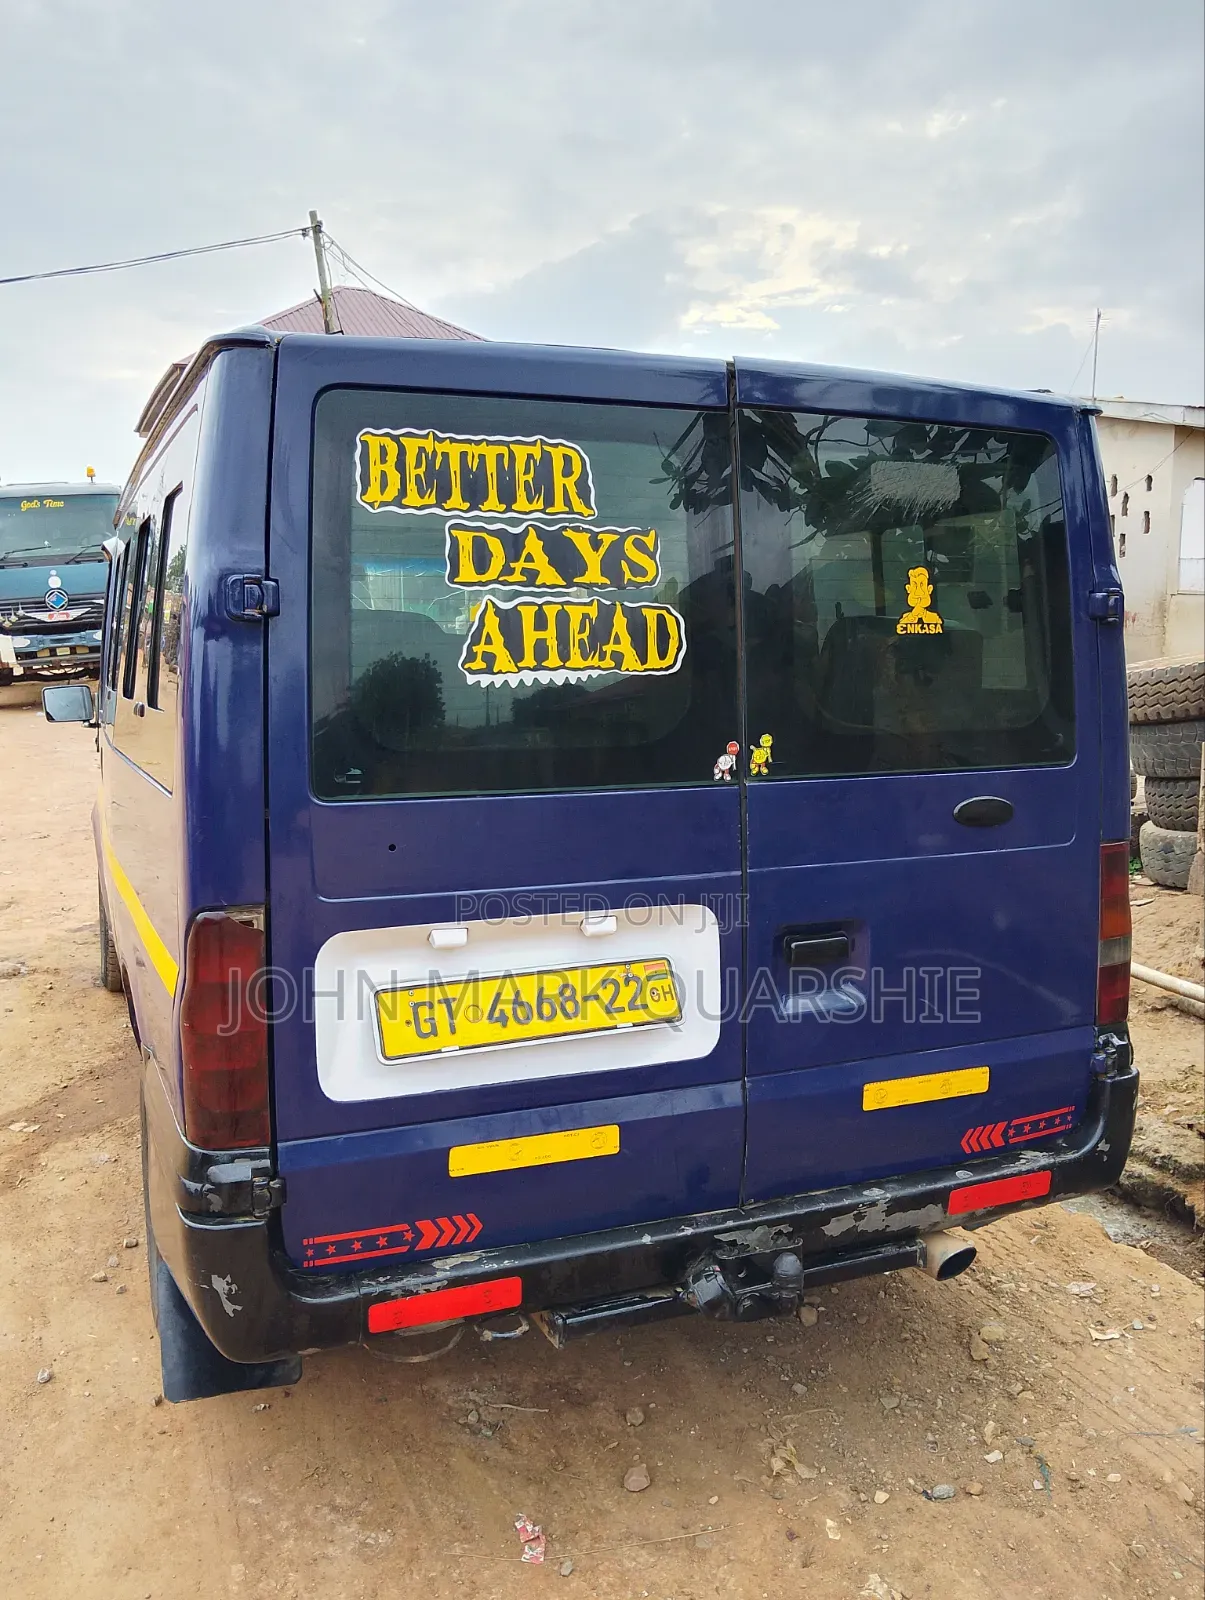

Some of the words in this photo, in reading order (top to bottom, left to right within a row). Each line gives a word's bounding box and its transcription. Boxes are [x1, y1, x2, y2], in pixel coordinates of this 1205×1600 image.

[360, 431, 594, 516] BETTER
[450, 526, 656, 586] DAYS
[463, 600, 680, 673] AHEAD
[412, 997, 458, 1040] GT
[650, 984, 675, 1003] GH
